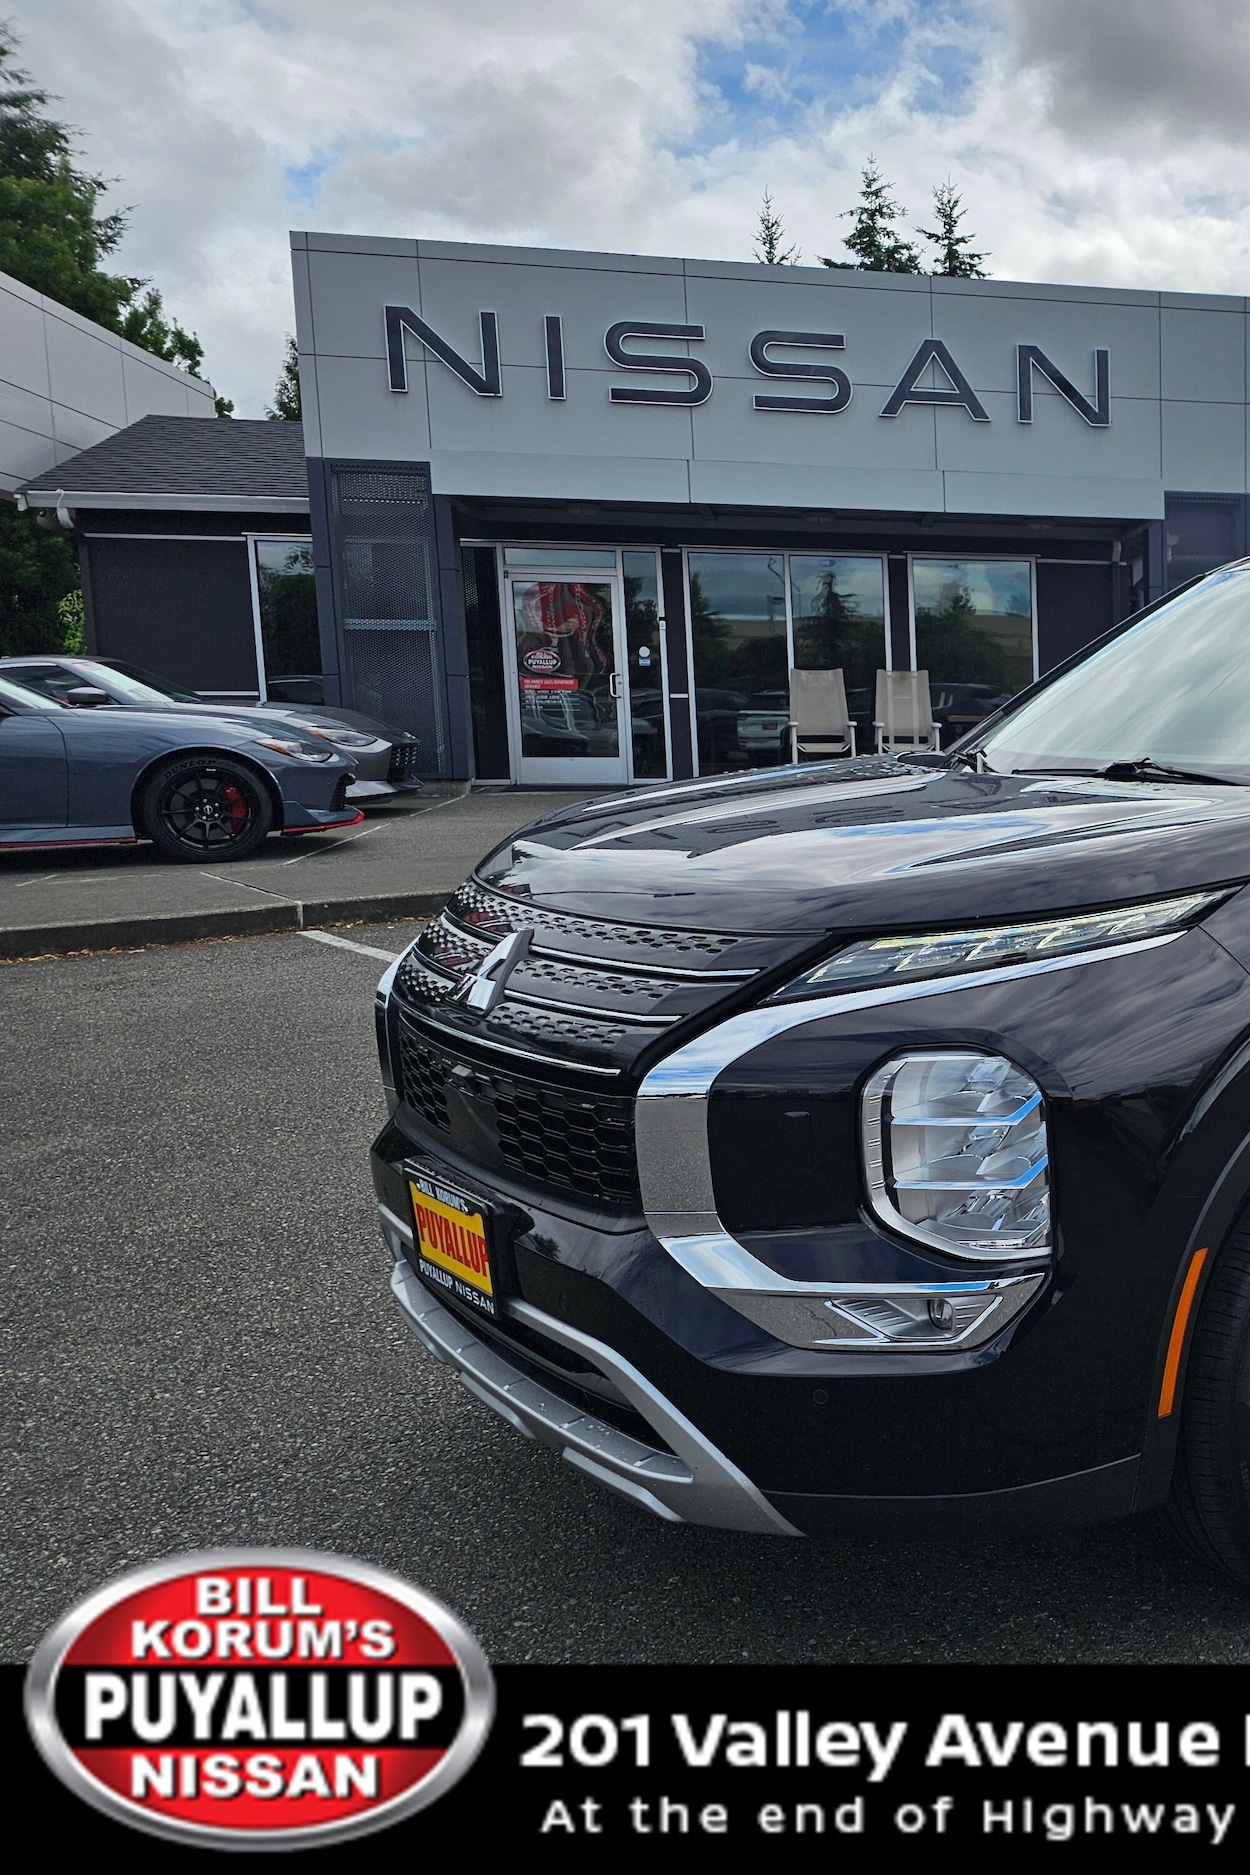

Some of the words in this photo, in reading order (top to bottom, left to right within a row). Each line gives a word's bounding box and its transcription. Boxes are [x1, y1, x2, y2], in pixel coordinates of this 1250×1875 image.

[383, 303, 1112, 428] NISSAN
[164, 759, 217, 780] DUNLOP
[419, 1178, 435, 1198] BILL
[435, 1186, 467, 1211] KORUM'S
[415, 1202, 489, 1277] PUYALLUP
[418, 1258, 453, 1289] PUYALLUP
[454, 1280, 495, 1315] NISSAN
